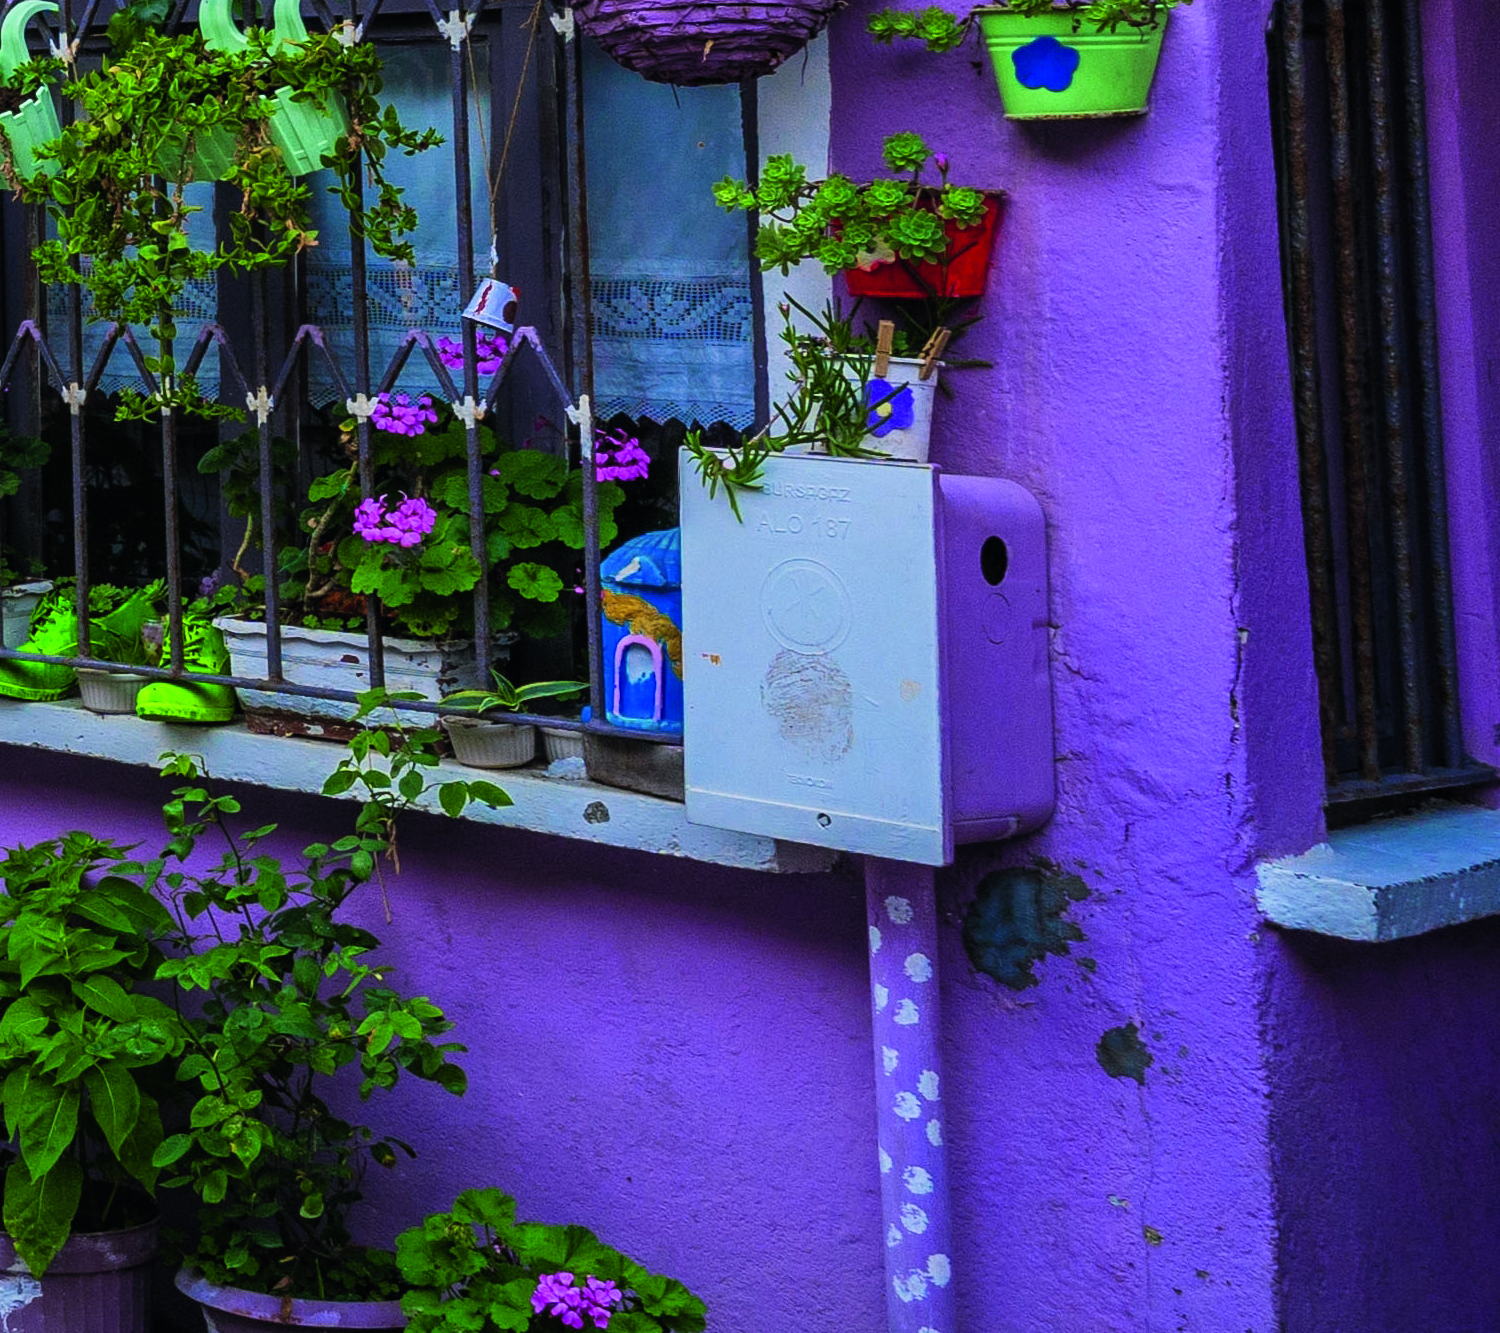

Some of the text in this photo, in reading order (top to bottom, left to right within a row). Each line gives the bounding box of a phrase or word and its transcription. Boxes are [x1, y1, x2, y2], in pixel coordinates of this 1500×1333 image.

[762, 481, 852, 503] BURSAGAZ
[756, 511, 853, 541] ALO 187
